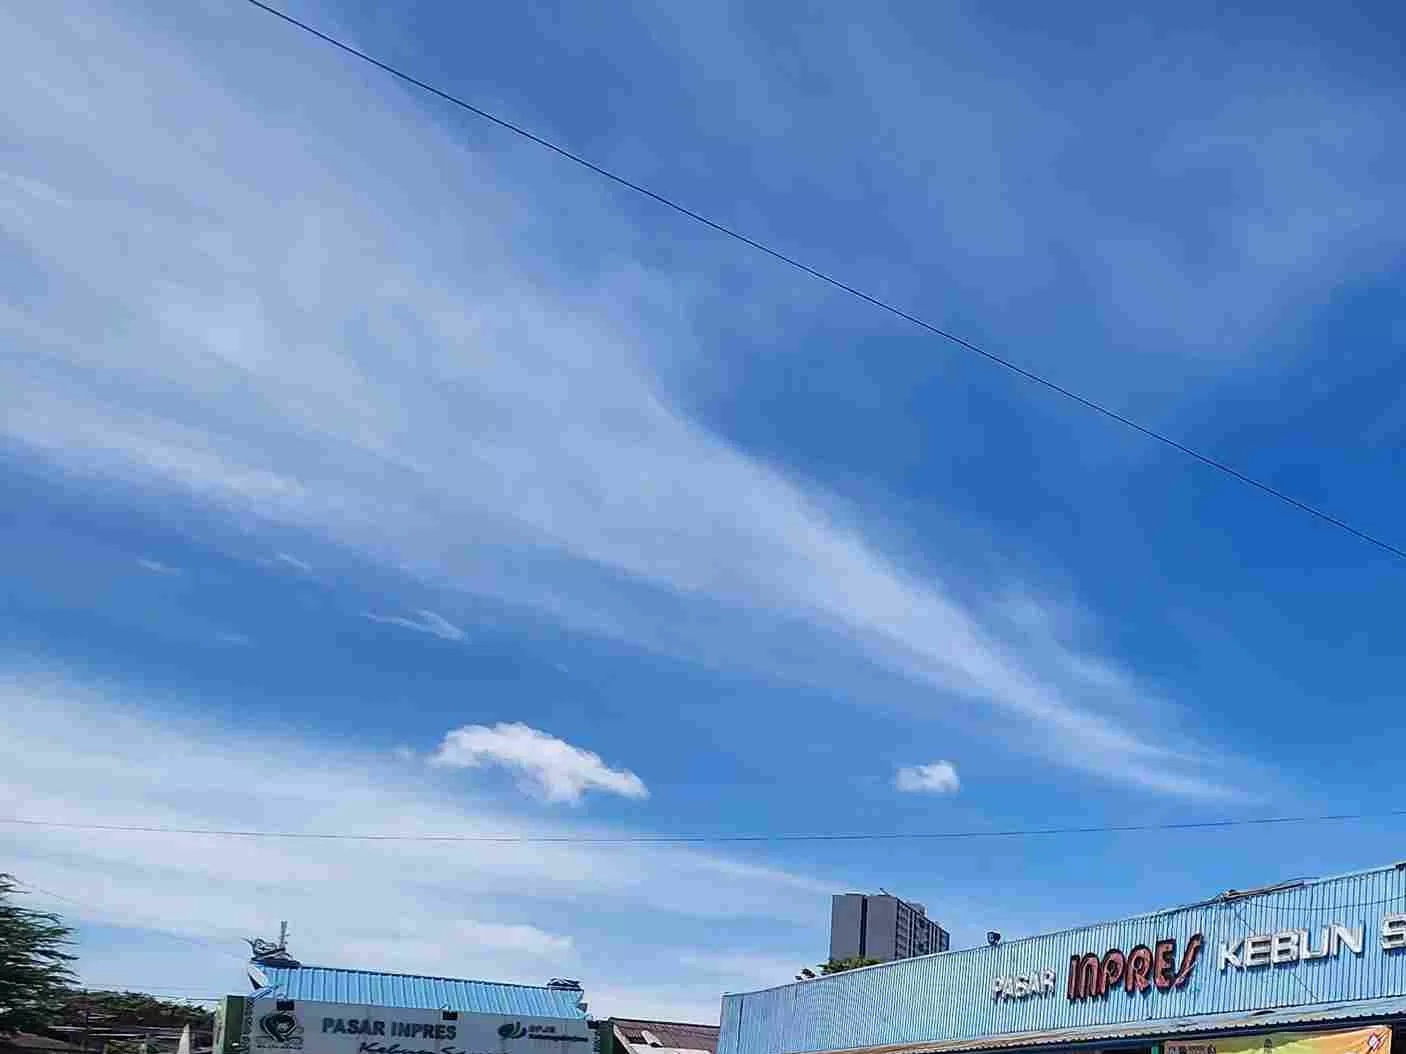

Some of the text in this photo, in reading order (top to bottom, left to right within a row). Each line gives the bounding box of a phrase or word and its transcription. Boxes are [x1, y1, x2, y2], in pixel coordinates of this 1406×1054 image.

[990, 967, 1056, 1001] PASAR
[1066, 932, 1204, 1002] INPRES
[1219, 920, 1365, 971] KEBUN
[322, 1018, 457, 1041] PASAR INPRES
